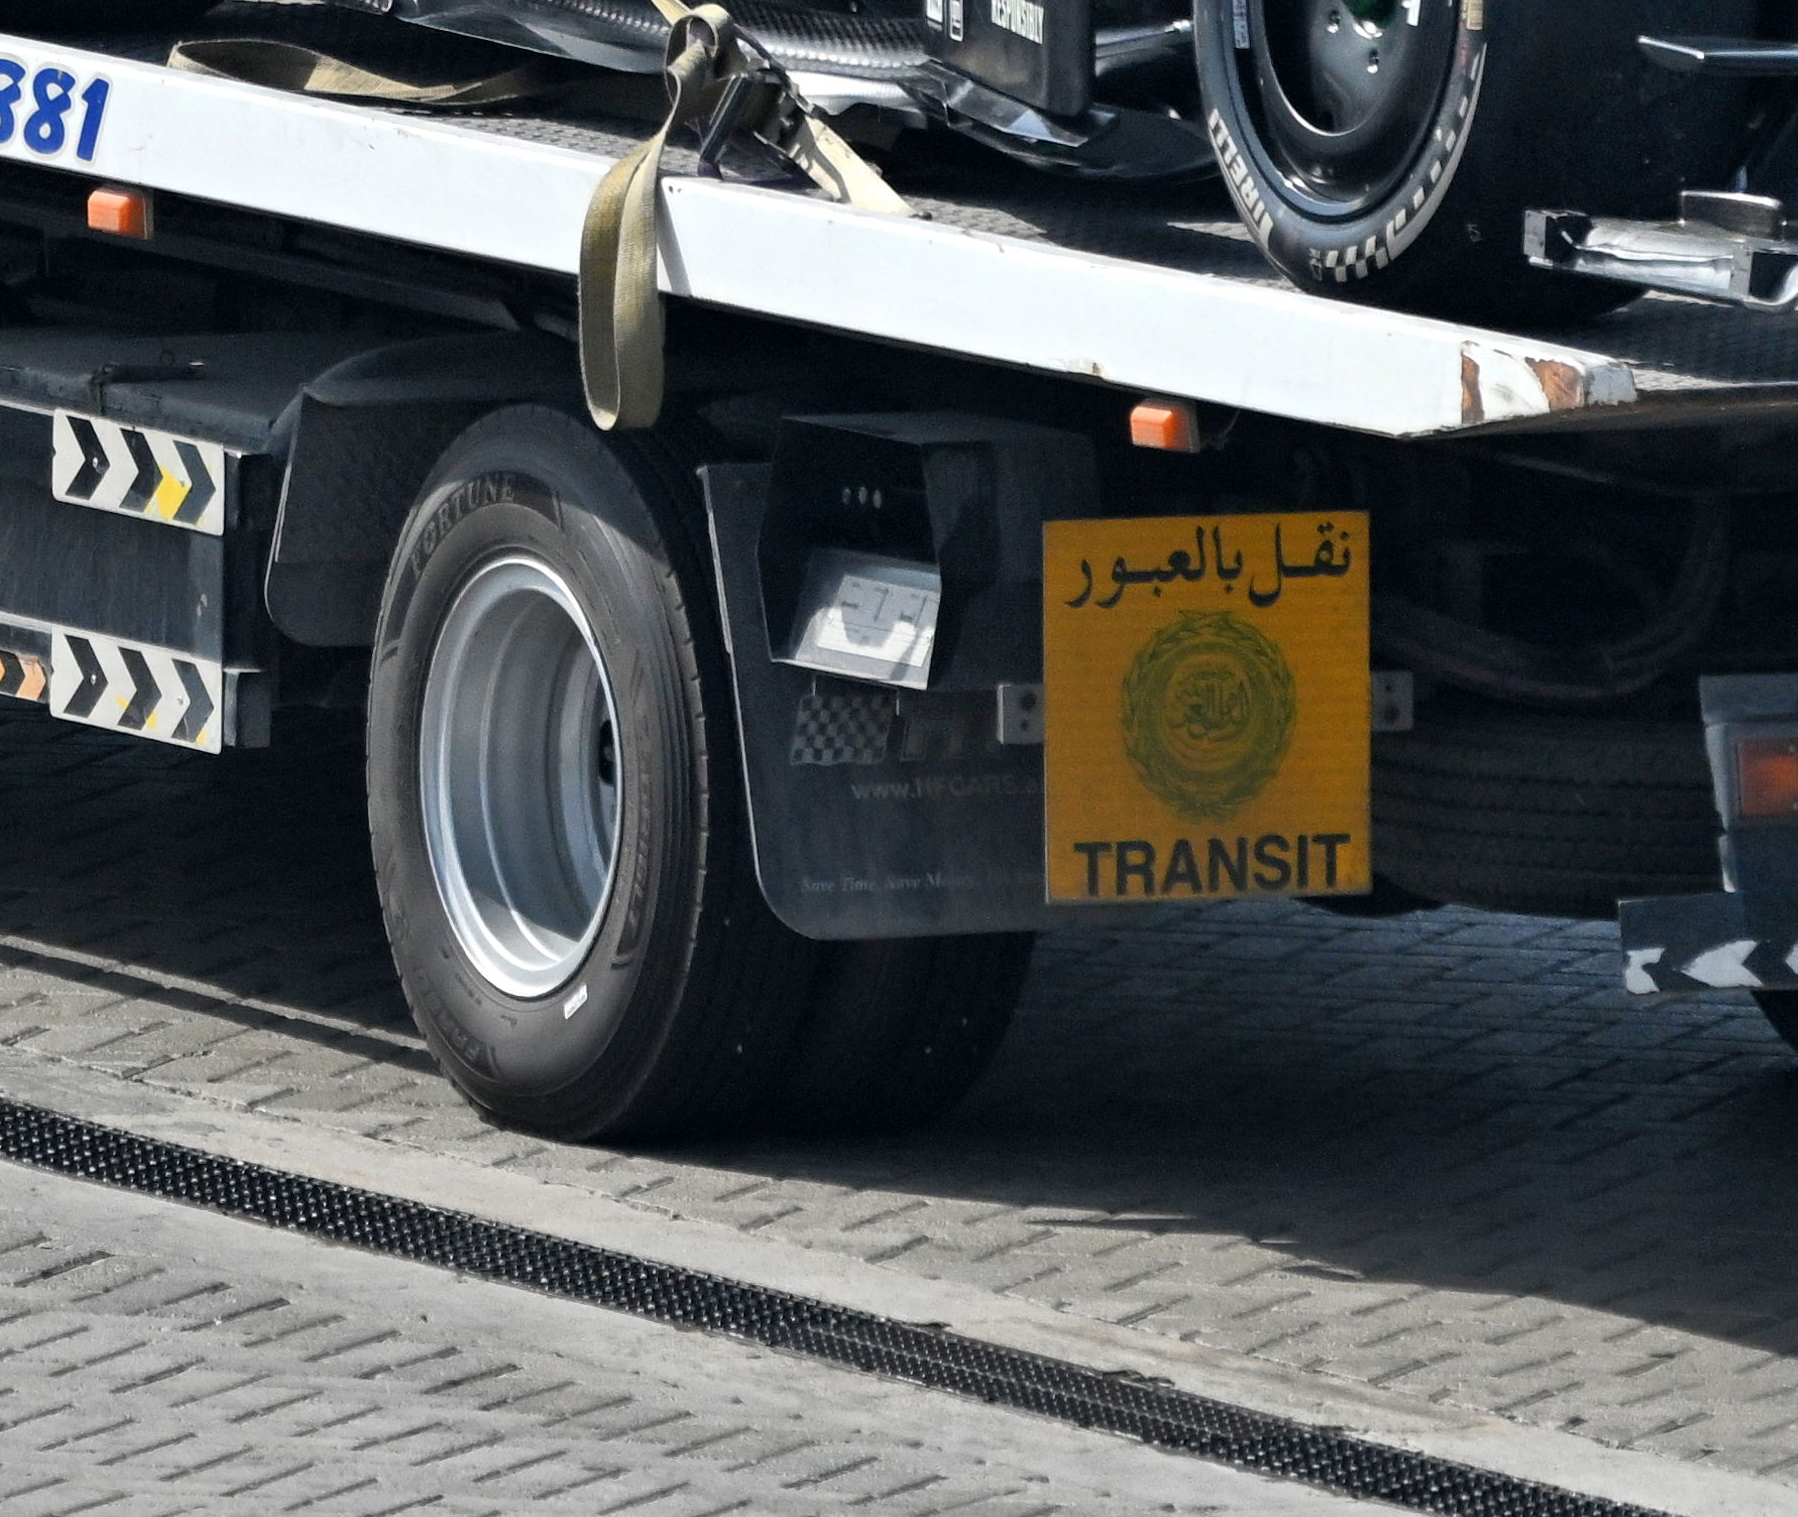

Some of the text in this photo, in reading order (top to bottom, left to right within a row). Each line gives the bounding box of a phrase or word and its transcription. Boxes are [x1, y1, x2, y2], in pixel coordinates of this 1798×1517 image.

[1065, 522, 1352, 608] نقل بالعبور
[1073, 832, 1351, 896] TRANSIT
